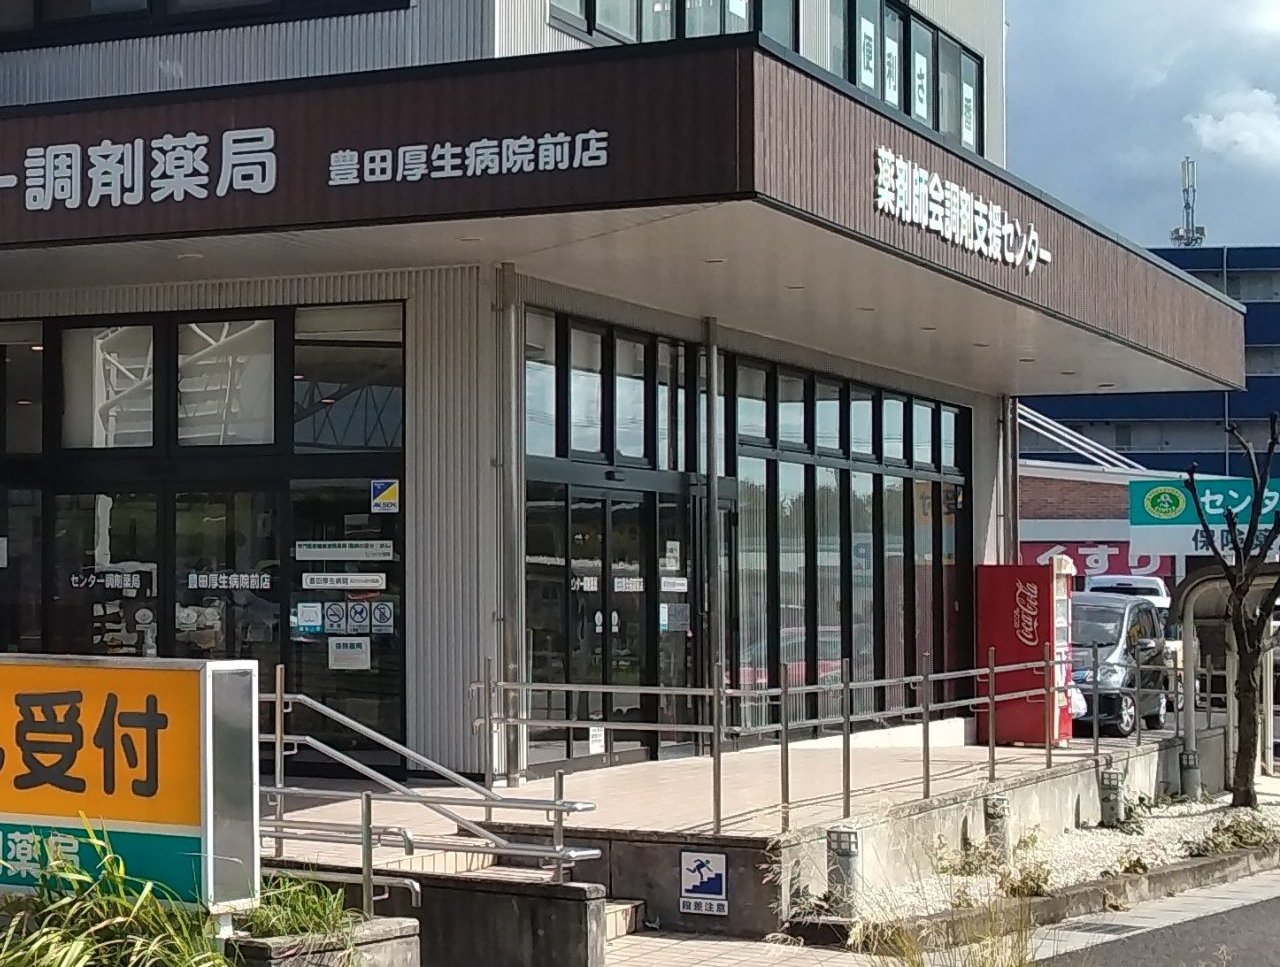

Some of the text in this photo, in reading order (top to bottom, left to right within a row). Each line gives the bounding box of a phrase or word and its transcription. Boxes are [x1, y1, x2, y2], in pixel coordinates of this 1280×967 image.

[328, 129, 610, 188] 豊田厚生病院前店
[188, 573, 271, 590] 豊田厚生病院前店
